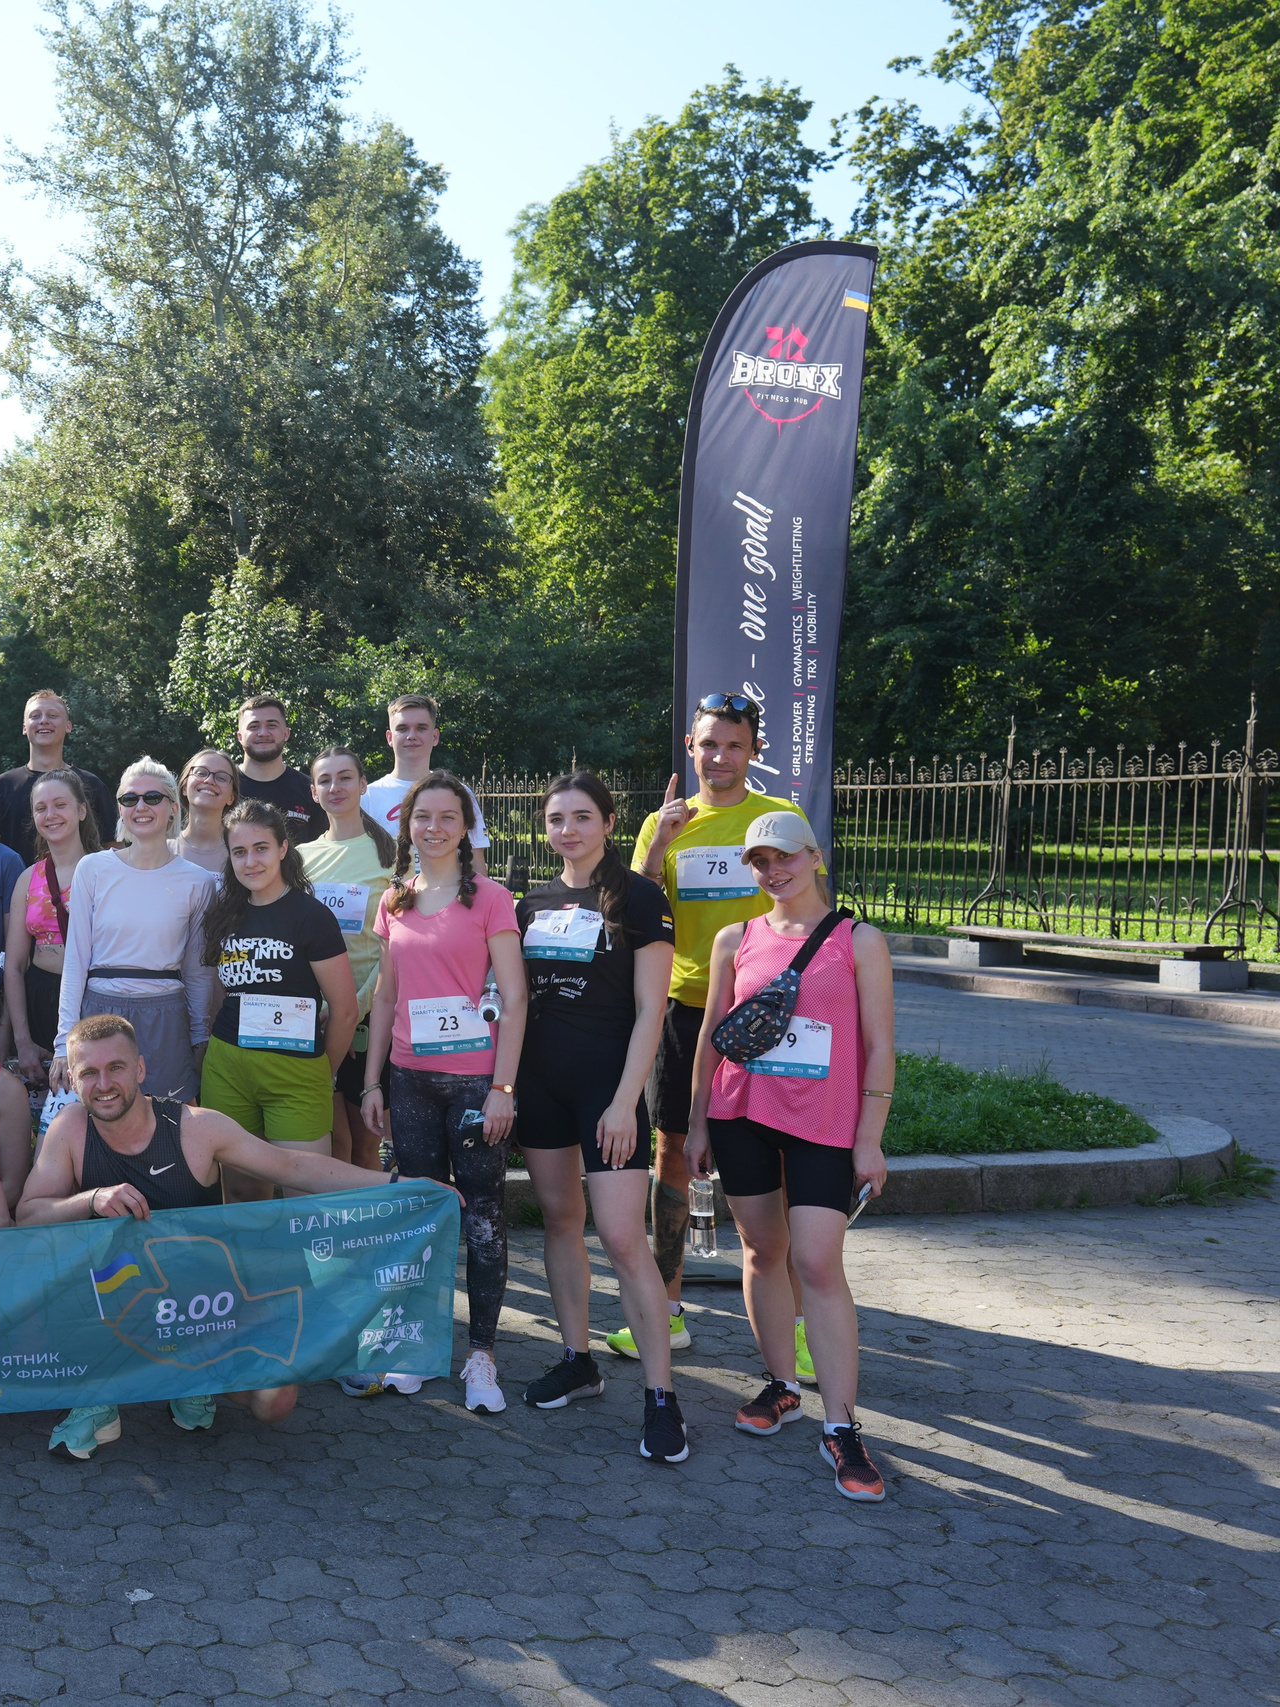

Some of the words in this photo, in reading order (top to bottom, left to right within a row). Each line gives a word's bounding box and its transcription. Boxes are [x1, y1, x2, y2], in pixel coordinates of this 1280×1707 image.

[729, 350, 842, 400] BRONX
[757, 393, 789, 403] FITNESS
[794, 397, 808, 405] HUB
[732, 491, 777, 582] goal!
[792, 517, 803, 601] WEIGHTLIFTING
[739, 582, 767, 641] one
[807, 592, 817, 644] MOBILITY
[793, 615, 803, 687] GYMNASTICS
[807, 659, 817, 680] TRX
[793, 701, 803, 740] POWER
[805, 694, 816, 764] STRETCHING
[792, 743, 802, 776] GIRLS
[288, 810, 310, 822] BRONX
[707, 861, 728, 875] 78
[322, 896, 344, 908] 106
[552, 923, 568, 934] 61
[255, 948, 293, 959] INTO
[273, 1012, 282, 1025] 8
[438, 1016, 459, 1031] 23
[775, 1033, 797, 1048] 9
[289, 1196, 433, 1233] BANKHOTEL
[342, 1235, 383, 1250] HEALTH
[386, 1223, 437, 1243] PATRONS
[378, 1264, 420, 1283] 1MEAL
[155, 1291, 235, 1325] 8.00
[156, 1327, 172, 1339] 13
[176, 1319, 237, 1339] серпня
[361, 1320, 424, 1346] BRONX
[157, 1342, 178, 1353] час
[16, 1365, 88, 1378] ФРАНКУ
